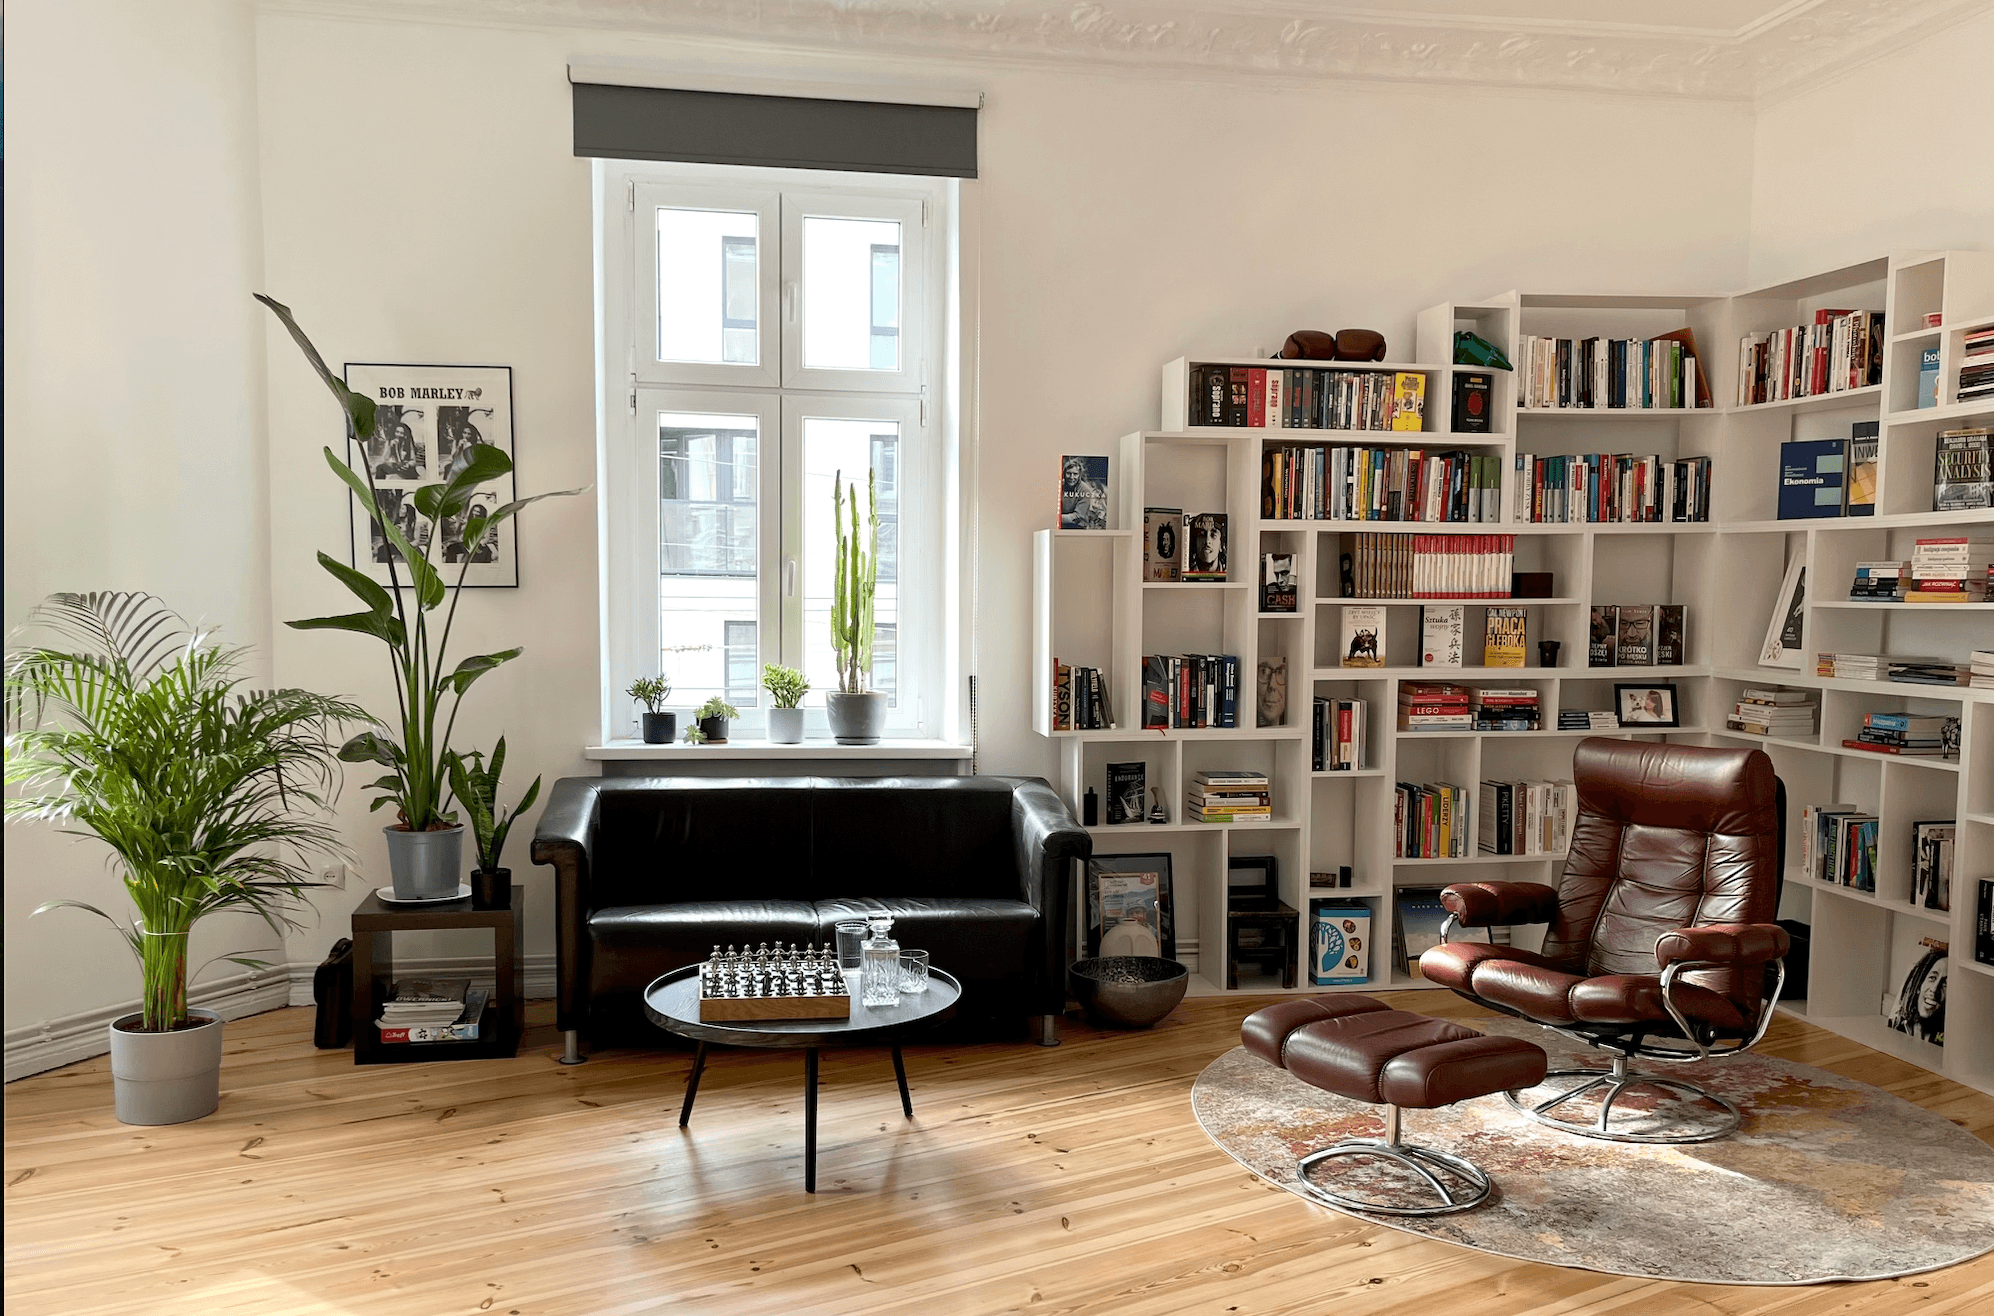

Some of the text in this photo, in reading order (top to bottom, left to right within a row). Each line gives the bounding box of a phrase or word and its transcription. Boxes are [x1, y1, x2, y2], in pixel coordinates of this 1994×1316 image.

[380, 387, 464, 400] BOB MARLEY
[1938, 450, 1990, 465] SECURITY
[1938, 464, 1991, 479] ANALYSIS
[1784, 477, 1824, 485] Ekonomia
[1267, 594, 1295, 605] CASH
[1487, 617, 1525, 634] PRACA
[1059, 670, 1070, 725] TYSON
